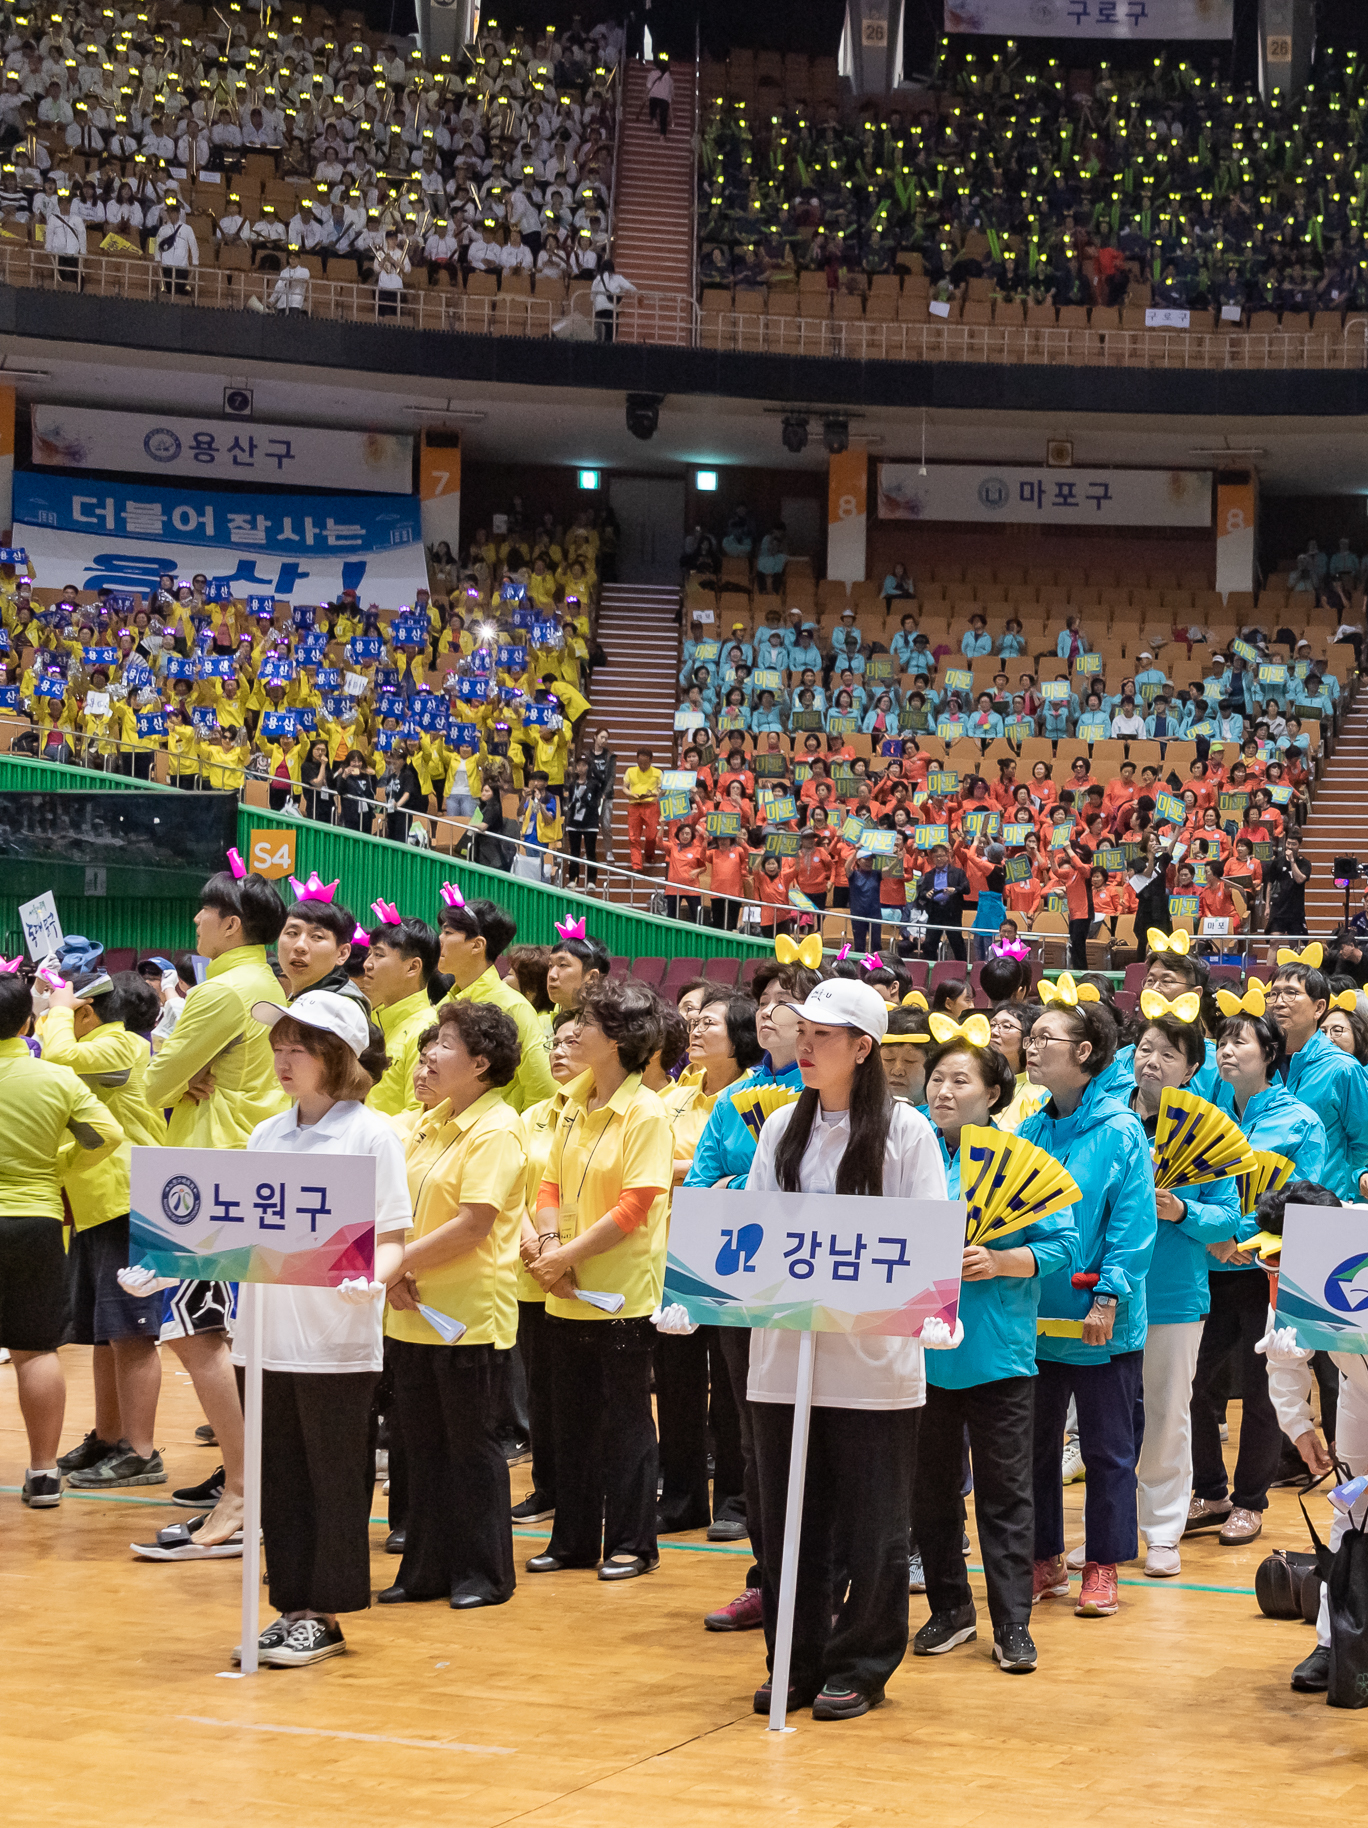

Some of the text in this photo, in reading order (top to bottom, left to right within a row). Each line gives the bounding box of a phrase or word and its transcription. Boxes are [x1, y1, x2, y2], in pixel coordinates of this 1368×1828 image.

[1067, 0, 1148, 26] 구로구
[866, 25, 884, 41] 26
[1272, 41, 1288, 56] 26
[188, 431, 296, 471] 용산구
[431, 471, 451, 497] 7
[1018, 479, 1113, 511] 마포구
[838, 495, 857, 519] 8
[71, 495, 367, 546] 더불어 잘사는
[1226, 508, 1246, 534] 8
[210, 584, 228, 597] 용산
[252, 600, 273, 610] 용산
[398, 627, 421, 641] 용산
[86, 650, 115, 661] 용산
[298, 649, 320, 661] 용산
[356, 641, 379, 653] 용산
[695, 644, 719, 660] 마포
[1234, 638, 1258, 664] 마포
[500, 650, 523, 663] 용산
[1076, 655, 1101, 674] 마포
[169, 662, 193, 675] 용산
[264, 663, 288, 675] 용산
[866, 661, 892, 679] 마포
[1259, 666, 1287, 683] 마포
[318, 672, 338, 684] 용산
[754, 671, 780, 688] 마포
[945, 671, 973, 690] 마포
[40, 680, 64, 695] 용산
[462, 681, 486, 695] 용산
[1042, 682, 1069, 700] 마포
[326, 699, 351, 712] 용산
[380, 700, 403, 714] 용산
[192, 712, 214, 725] 용산
[422, 714, 446, 729] 용산
[529, 708, 552, 722] 용산
[675, 712, 703, 729] 마포
[140, 718, 163, 731] 용산
[450, 726, 472, 740] 용산
[830, 718, 857, 733] 마포
[938, 723, 964, 741] 마포
[1079, 725, 1105, 742] 마포
[662, 772, 696, 789] 마포
[928, 773, 958, 795] 마포
[660, 794, 689, 819] 마포
[766, 798, 796, 822] 마포
[1158, 794, 1185, 822] 마포
[707, 813, 740, 836] 마포
[766, 834, 800, 856] 마포
[861, 831, 895, 851] 마포
[916, 827, 948, 849] 마포
[253, 841, 292, 869] S4
[1093, 850, 1123, 870] 마포
[1169, 898, 1198, 917] 마포
[208, 1182, 333, 1233] 노원구
[783, 1230, 911, 1284] 강남구
